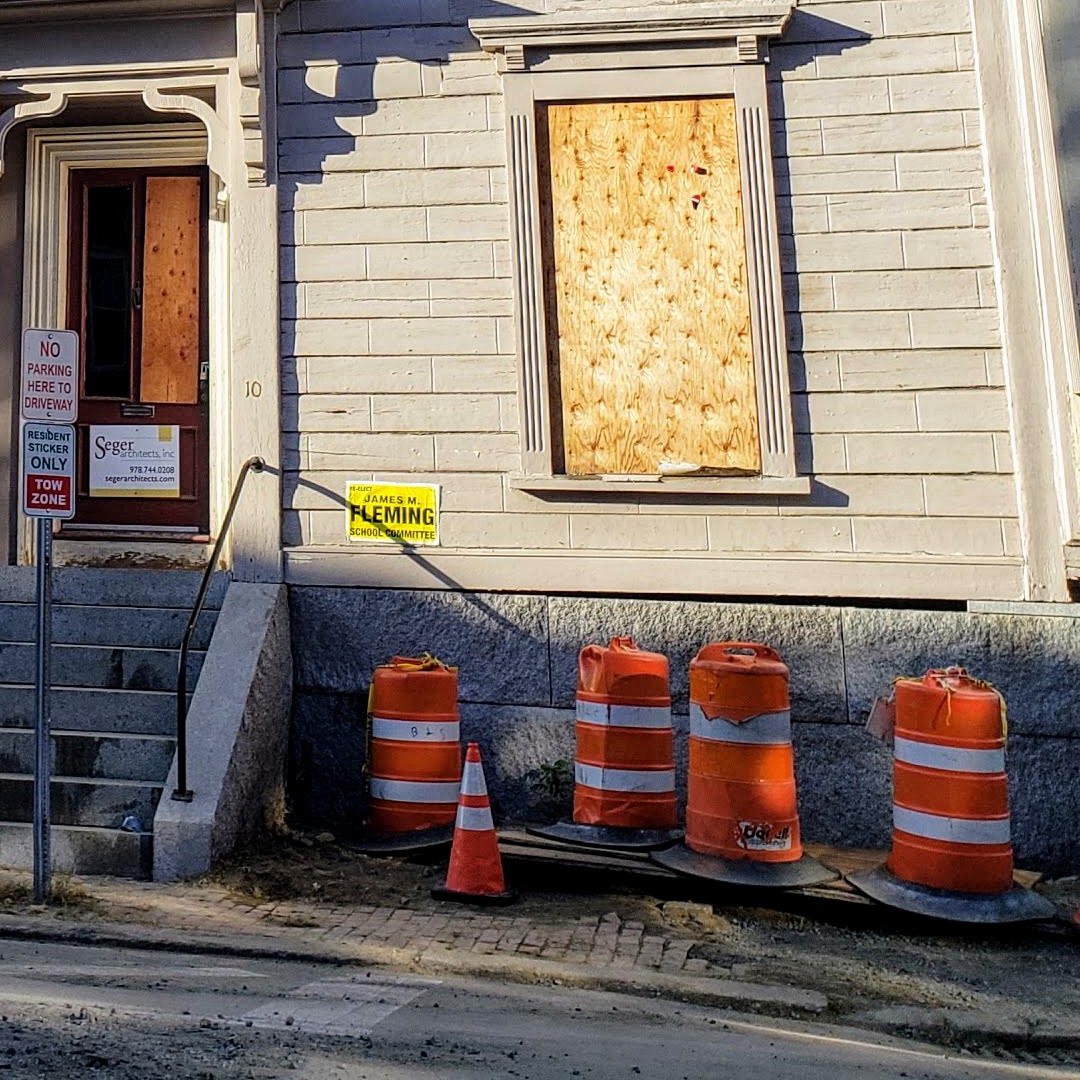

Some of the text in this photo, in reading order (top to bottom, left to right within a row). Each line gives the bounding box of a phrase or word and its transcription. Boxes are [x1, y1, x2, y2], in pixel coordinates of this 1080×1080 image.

[40, 341, 60, 358] NO
[28, 363, 72, 376] PARKING
[28, 381, 72, 394] HERE TO
[246, 381, 262, 398] 10
[25, 397, 73, 411] DRIVEWAY
[28, 430, 71, 442] RESIDENT
[28, 443, 69, 454] STICKER
[94, 436, 134, 460] Seger
[162, 449, 175, 458] inc
[31, 456, 68, 470] ONLY
[34, 479, 62, 490] TOW
[105, 476, 174, 484] segerarchitects.com
[31, 493, 66, 506] ZONE
[364, 495, 404, 504] JAMES
[350, 504, 434, 525] FLEMING
[350, 528, 436, 539] SCHOOL COMMITTEE
